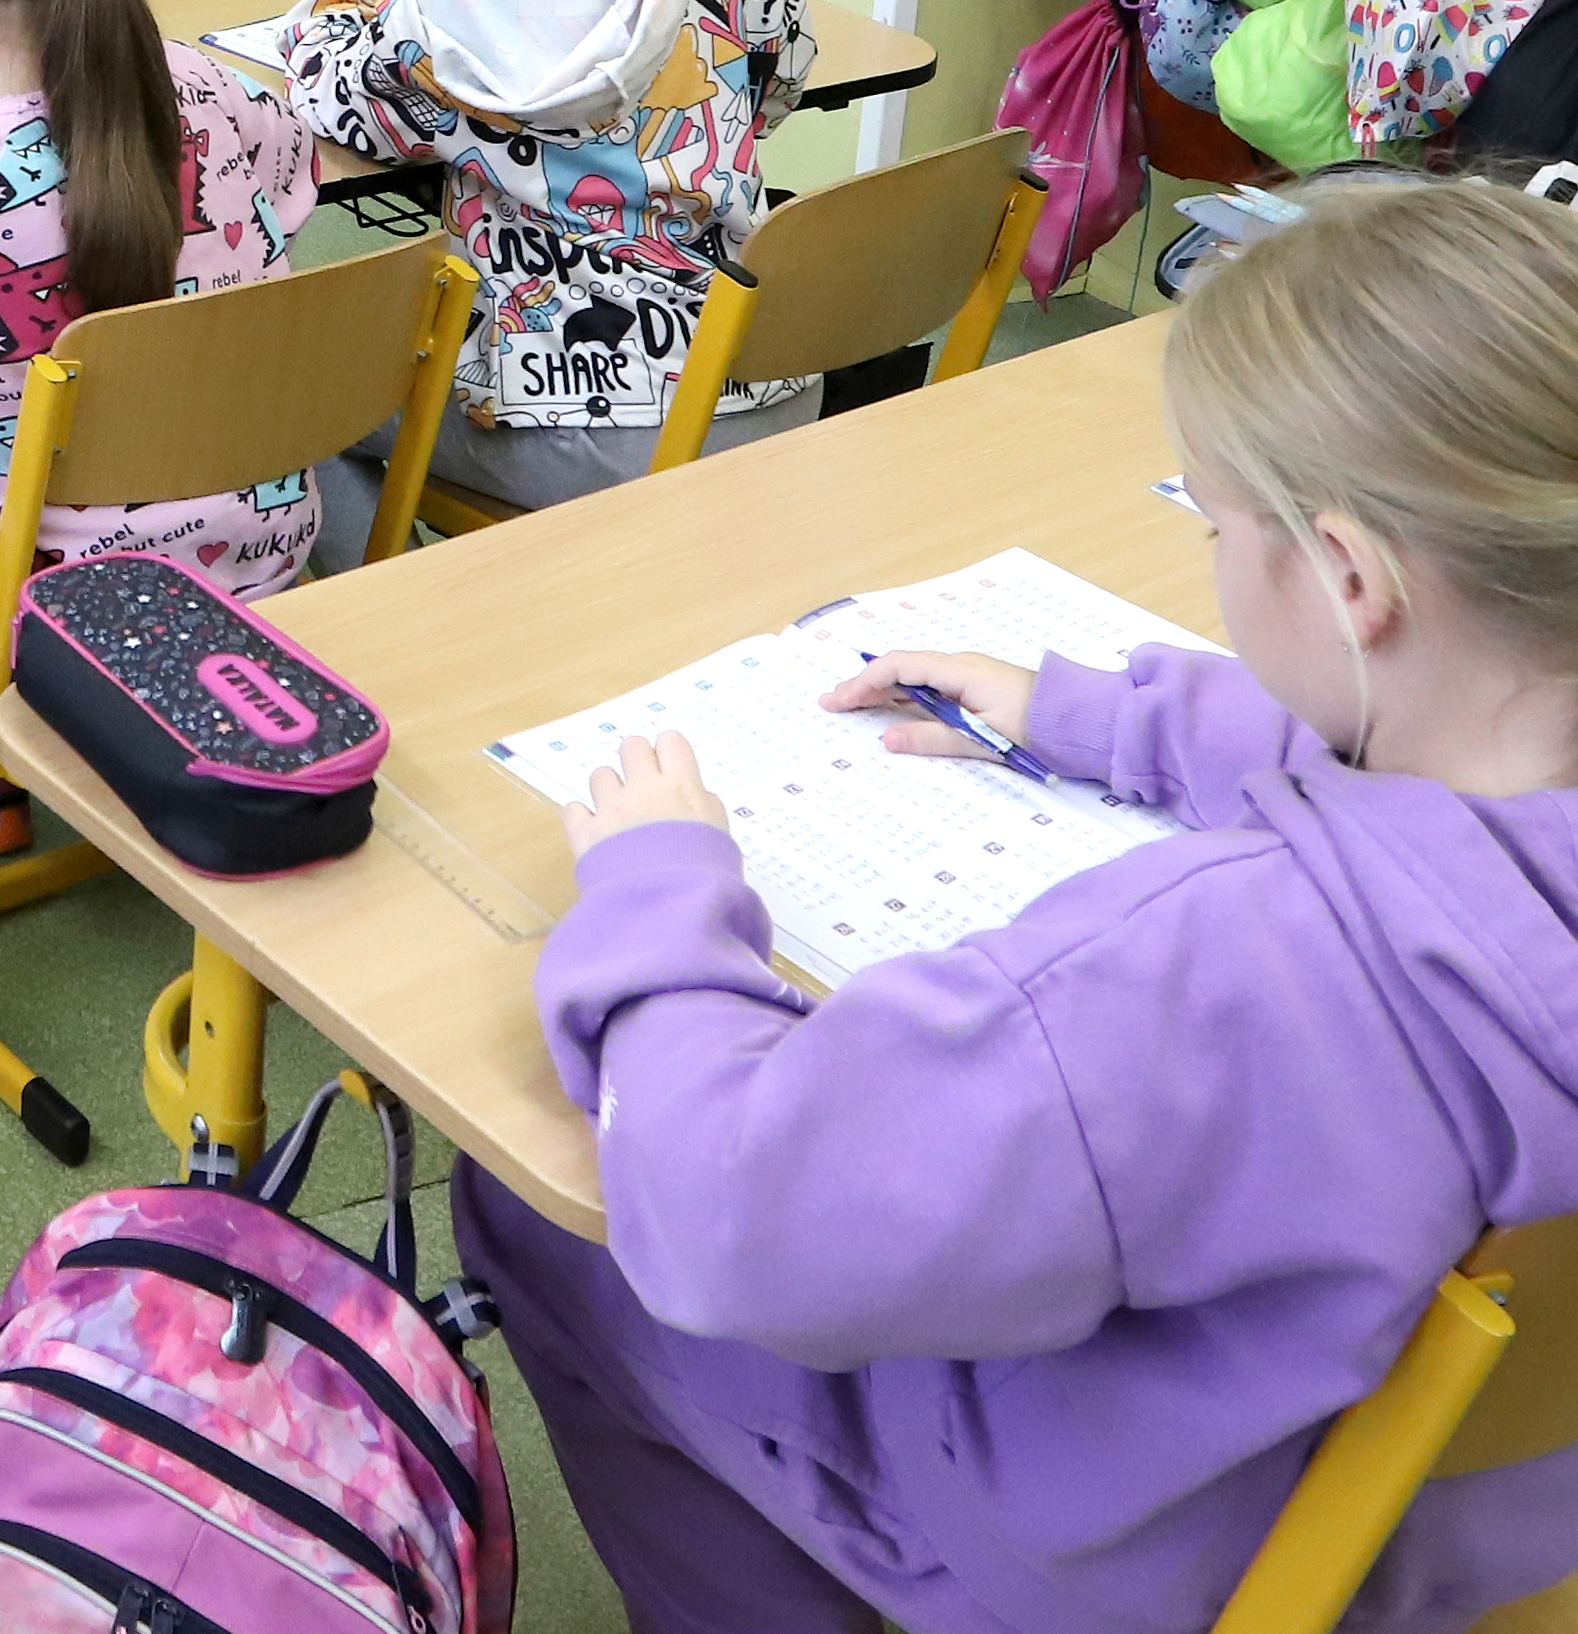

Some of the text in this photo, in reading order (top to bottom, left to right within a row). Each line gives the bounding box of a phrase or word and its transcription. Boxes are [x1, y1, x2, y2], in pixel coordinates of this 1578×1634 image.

[212, 270, 242, 289] rebel
[79, 523, 135, 559] rebel
[161, 517, 205, 544] cute
